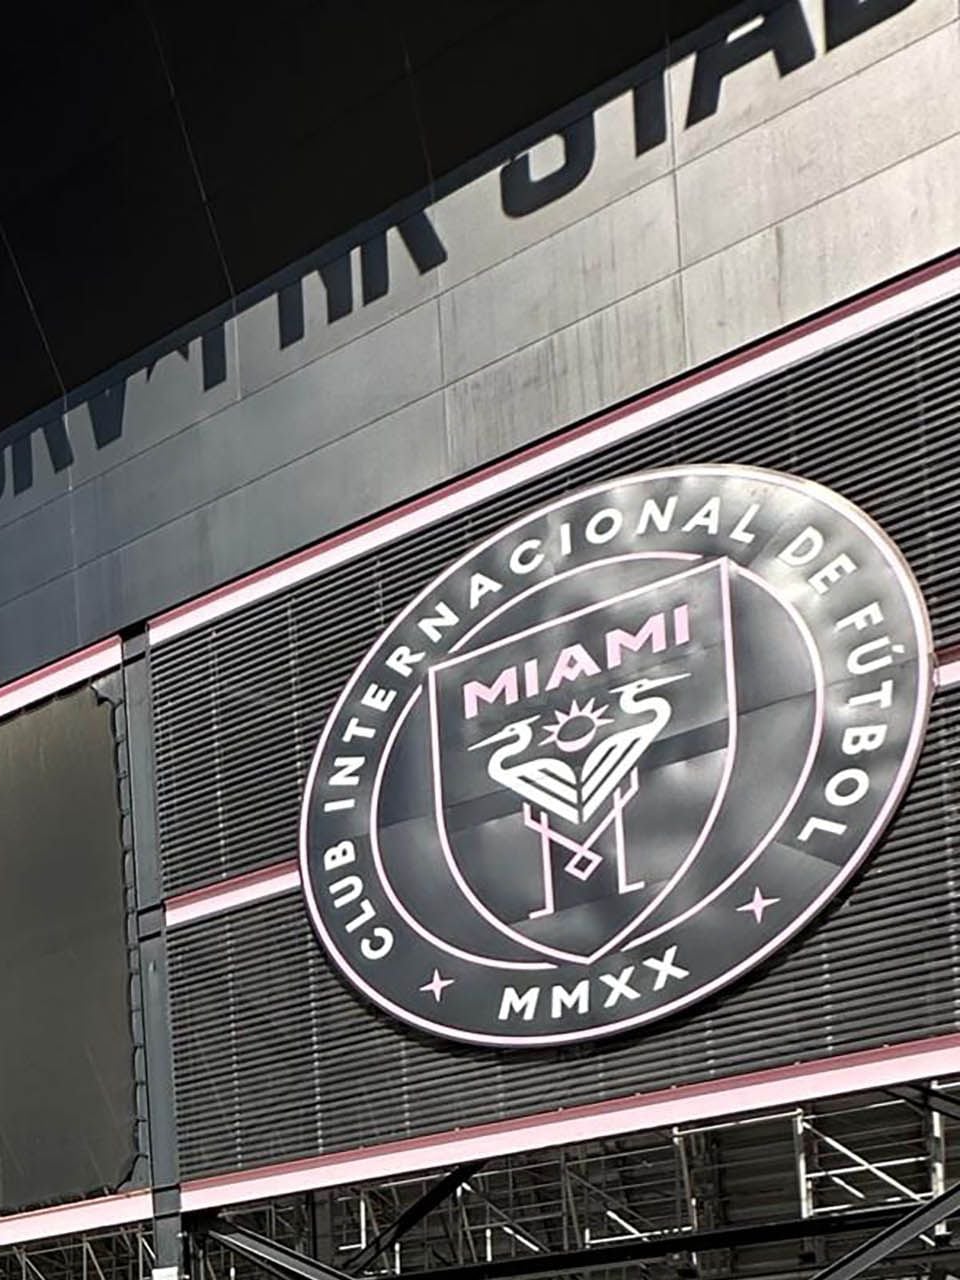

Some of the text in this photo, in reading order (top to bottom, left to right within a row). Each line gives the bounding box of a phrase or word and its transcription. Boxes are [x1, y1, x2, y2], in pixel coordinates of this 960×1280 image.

[463, 604, 692, 720] MIAMI
[324, 496, 907, 961] CLUB INTERNACIONAL DE FÚTBOL
[498, 945, 690, 1021] MMXX
